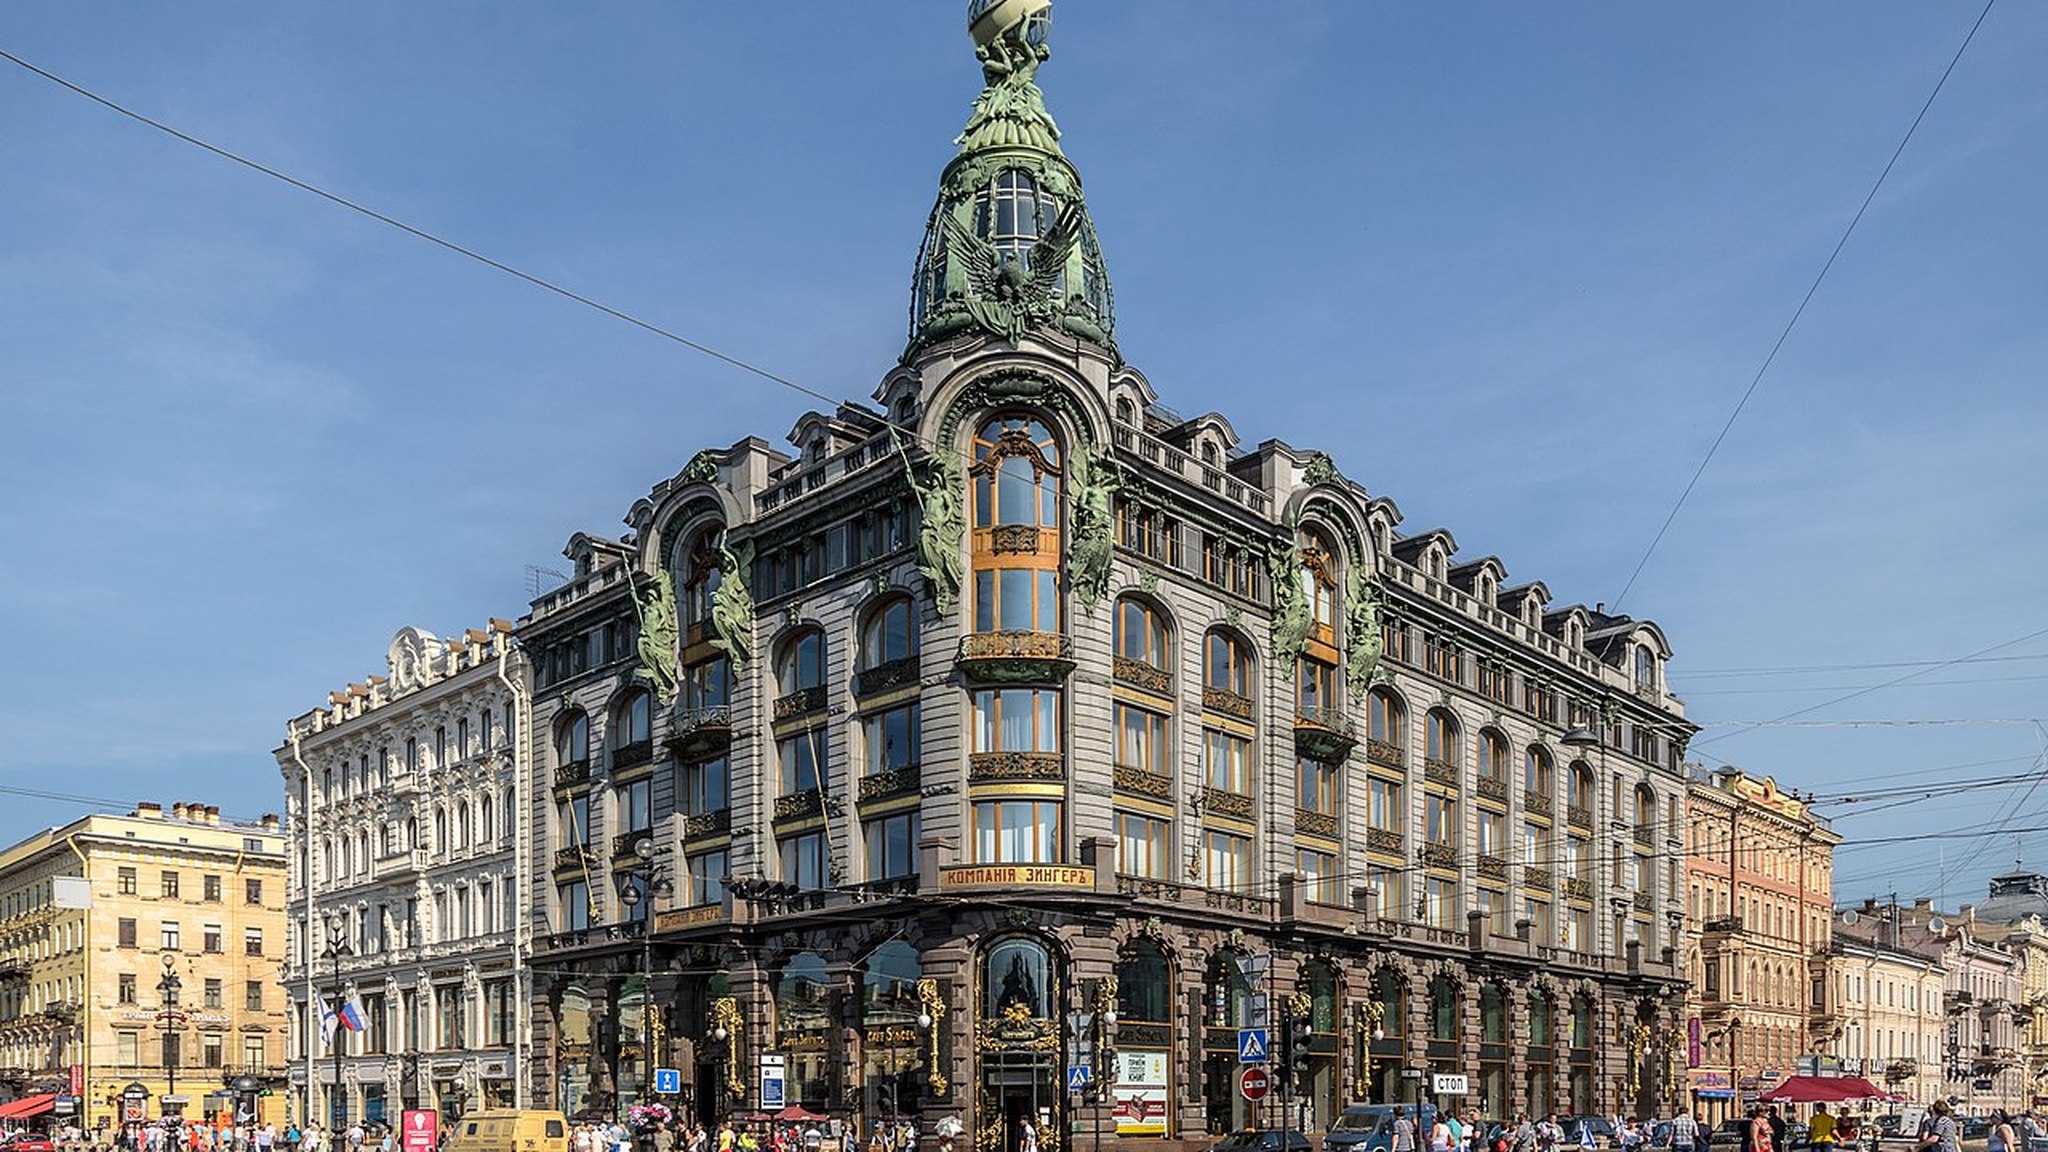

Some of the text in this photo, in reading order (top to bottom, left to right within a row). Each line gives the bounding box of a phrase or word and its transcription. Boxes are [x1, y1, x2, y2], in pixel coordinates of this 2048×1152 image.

[948, 867, 1087, 884] КОМПАНІЯ ЗИНГЕРЪ
[1438, 1078, 1463, 1090] СТОП
